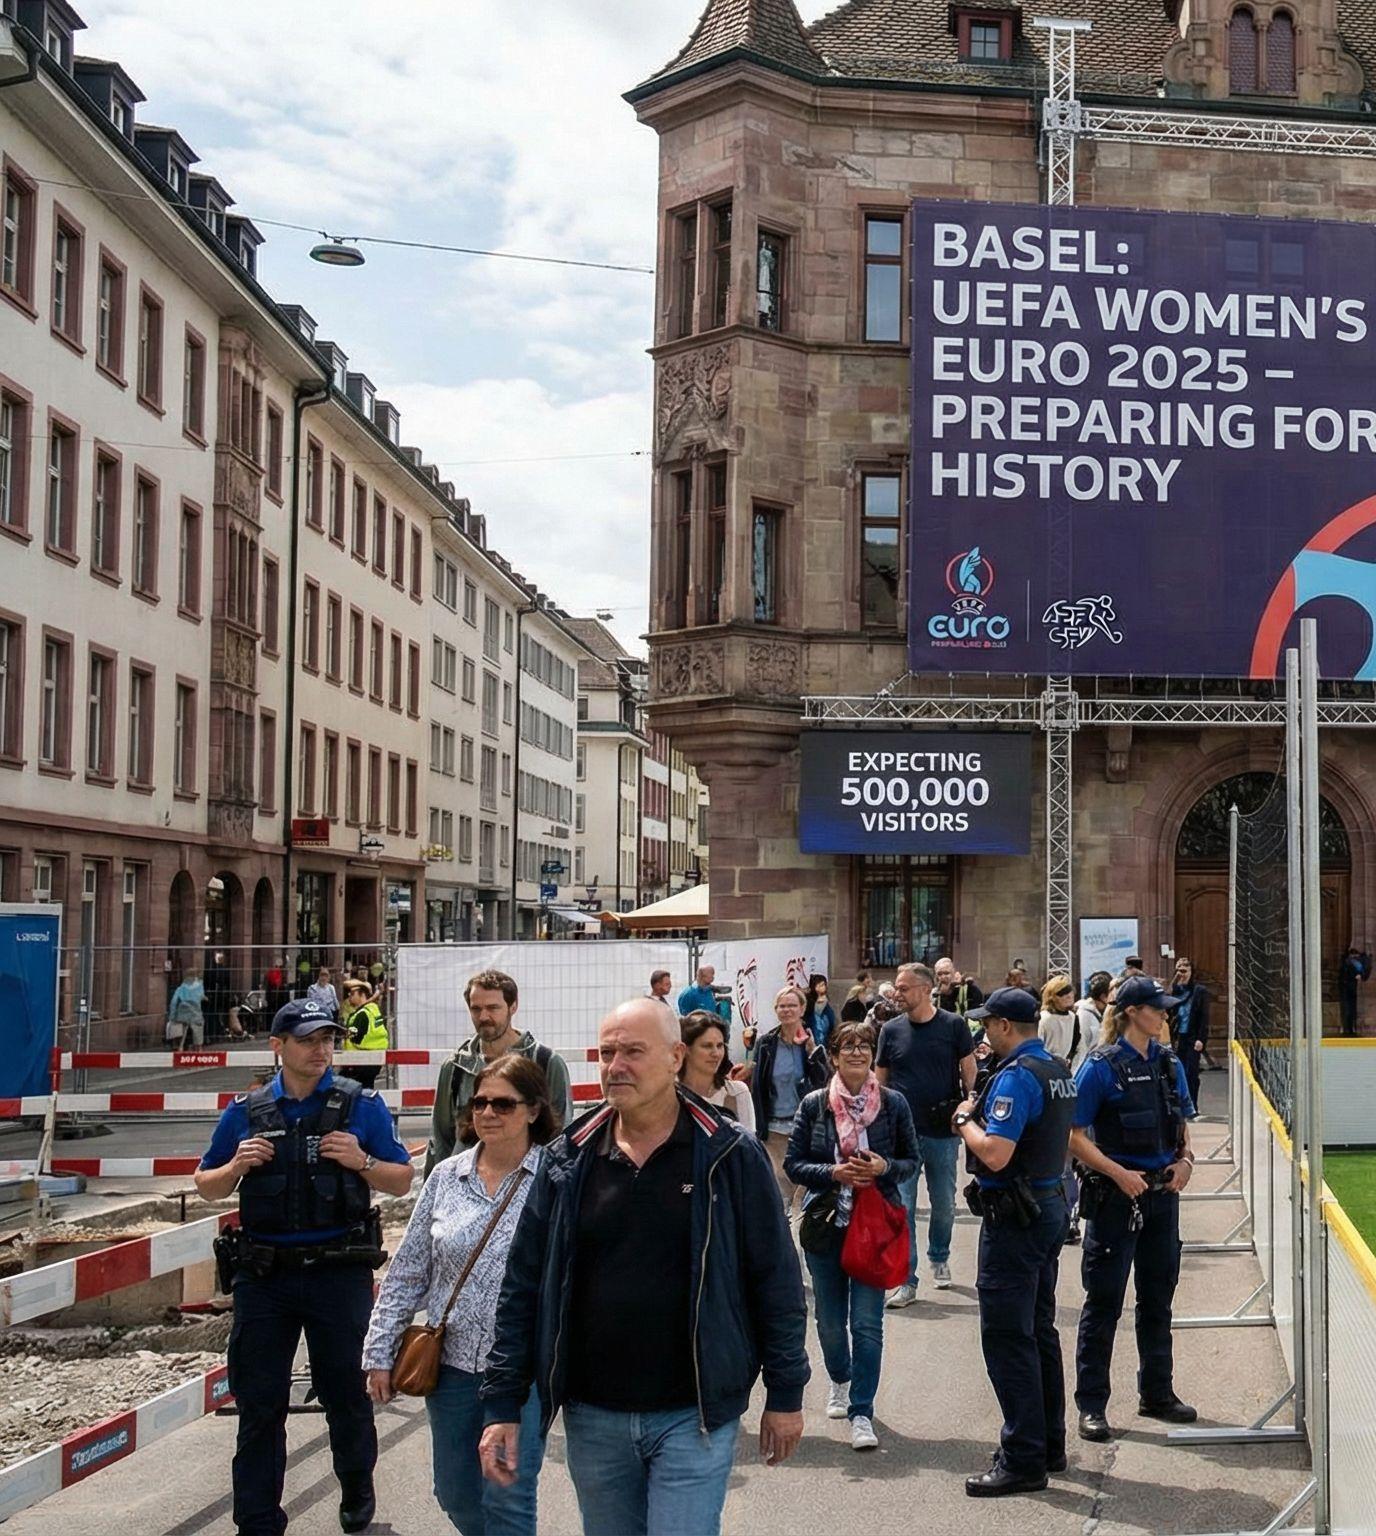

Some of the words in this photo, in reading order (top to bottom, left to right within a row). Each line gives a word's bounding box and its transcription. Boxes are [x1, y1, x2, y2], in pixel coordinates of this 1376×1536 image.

[933, 222, 1130, 275] BASEL:
[933, 279, 1081, 330] UEFA
[1094, 287, 1368, 343] WOMEN'S
[933, 336, 1091, 386] EURO
[1107, 343, 1250, 393] 2025
[932, 390, 1255, 449] PREPARING
[931, 451, 1182, 502] HISTORY
[848, 751, 982, 772] EXPECTING
[841, 776, 990, 810] 500,000
[860, 812, 969, 832] VISITORS
